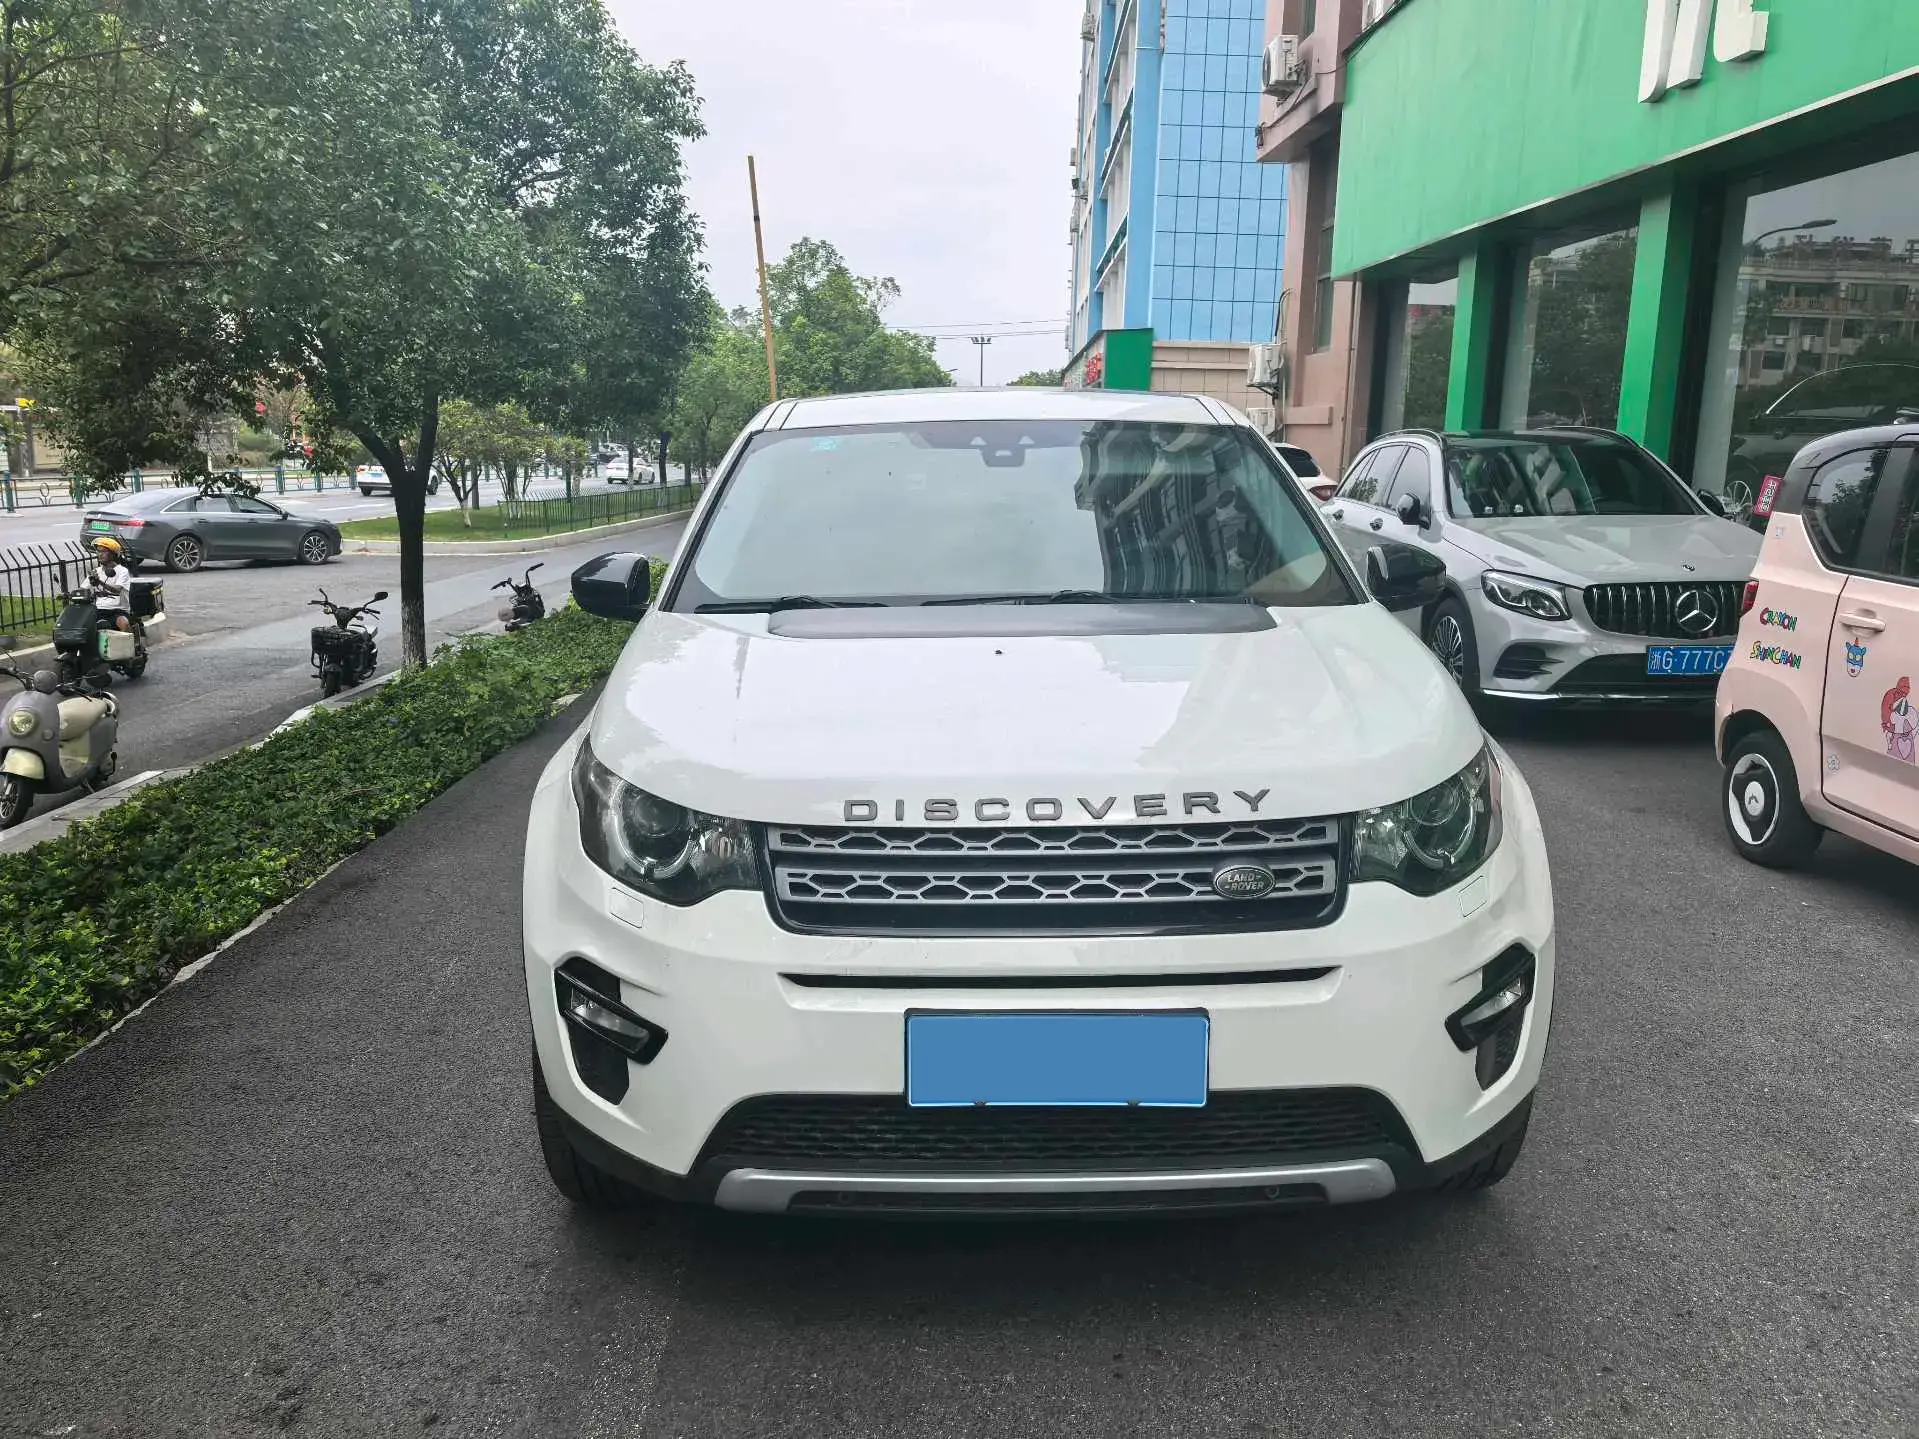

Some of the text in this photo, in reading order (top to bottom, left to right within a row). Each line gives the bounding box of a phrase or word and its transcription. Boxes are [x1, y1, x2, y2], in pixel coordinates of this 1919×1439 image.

[1760, 607, 1797, 632] CRAYON
[1649, 649, 1733, 671] 浙G·777C
[844, 788, 1270, 822] DISCOVERY
